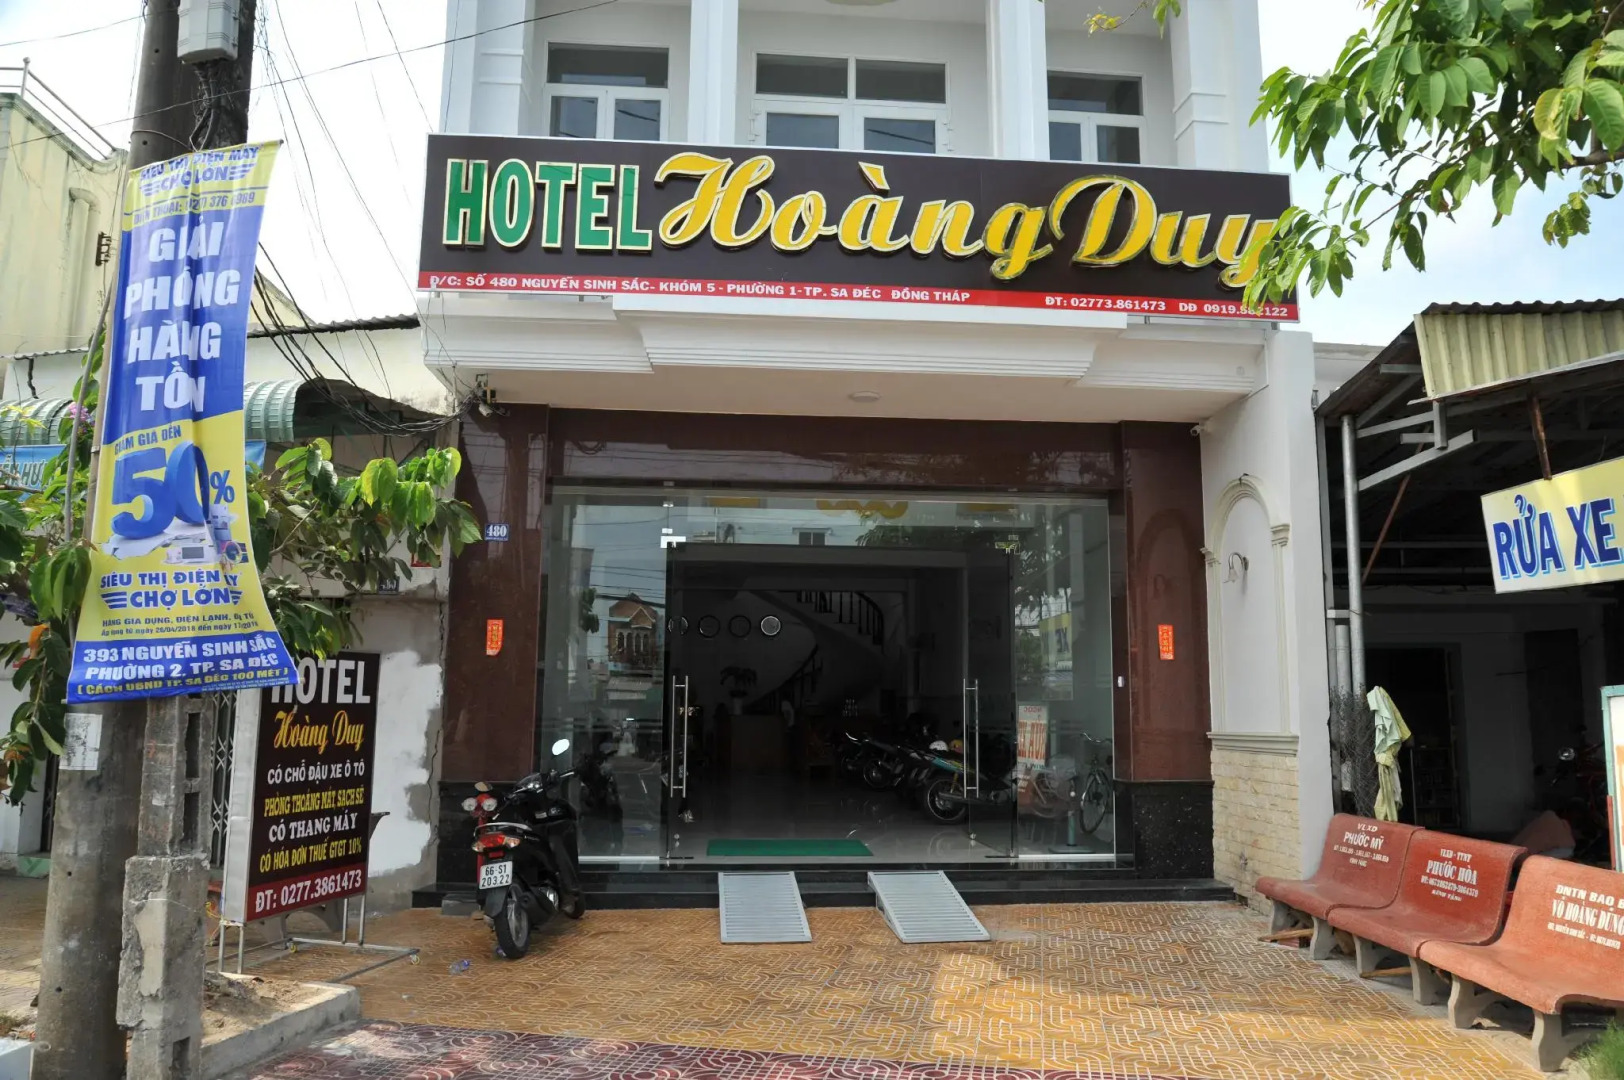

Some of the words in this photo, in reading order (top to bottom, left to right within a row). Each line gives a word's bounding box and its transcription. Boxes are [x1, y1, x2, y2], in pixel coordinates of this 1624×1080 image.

[441, 157, 654, 252] HOTEL
[653, 151, 1055, 282] Hoàng
[1048, 174, 1281, 291] Duy
[149, 215, 225, 262] GIẢI
[466, 272, 487, 287] SỐ
[489, 277, 518, 288] 480
[521, 276, 580, 290] NGUYỄN
[583, 279, 617, 290] SINH
[659, 280, 702, 293] KHÓM
[706, 283, 716, 293] 5
[727, 282, 785, 296] PHƯỜNG
[830, 287, 848, 298] SA
[852, 286, 882, 299] ĐÉC
[891, 286, 930, 300] ĐỒNG
[933, 289, 971, 302] THÁP
[1044, 296, 1068, 307] ĐT:
[1070, 297, 1167, 312] 02773.861473
[127, 319, 222, 365] HÀNG
[135, 360, 206, 413] TỒN
[486, 524, 508, 537] 480
[1492, 494, 1566, 580] RỬA
[1565, 497, 1624, 571] XE
[100, 571, 132, 589] SIÊU
[138, 572, 167, 590] THỊ
[173, 568, 220, 588] ĐIỆN
[129, 590, 178, 611] CHỢ
[182, 584, 231, 607] LỚN
[124, 617, 142, 626] GIA
[83, 647, 119, 663] 393
[122, 641, 198, 661] NGUYỄN
[202, 640, 248, 657] SINH
[249, 633, 277, 653] SẮC
[85, 663, 165, 681] PHƯỜNG
[220, 658, 245, 671] SA
[248, 653, 279, 667] ĐÉC
[86, 683, 123, 695] CÁCH
[125, 679, 163, 691] UBND
[185, 676, 203, 686] SA
[232, 670, 255, 681] 100
[274, 709, 329, 755] Hoàng
[331, 709, 365, 752] Duy
[267, 764, 283, 785] CÓ
[284, 759, 306, 783] CHỖ
[308, 761, 329, 785] ĐẬU
[330, 763, 343, 779] XE
[344, 759, 352, 778] Ô
[353, 758, 365, 777] TÔ
[263, 791, 291, 818] PHÒNG
[292, 787, 321, 814] THOÁNG
[337, 787, 355, 811] SẠCH
[268, 818, 286, 843] CÓ
[289, 817, 331, 840] THANG
[333, 809, 359, 832] MÁY
[1356, 822, 1379, 833] VLXD
[259, 847, 272, 874] CÓ
[273, 845, 289, 871] HÓA
[291, 846, 307, 868] ĐƠN
[309, 836, 328, 863] THUẾ
[329, 839, 347, 860] GTGT
[348, 836, 363, 855] 10%
[1343, 831, 1370, 848] PHƯỚC
[1370, 835, 1384, 851] MỸ
[485, 864, 507, 876] 66-S1
[1457, 864, 1478, 886] HÒA
[255, 889, 277, 913] ĐT:
[280, 869, 363, 907] 0277.3861473
[1555, 884, 1587, 901] DNTN
